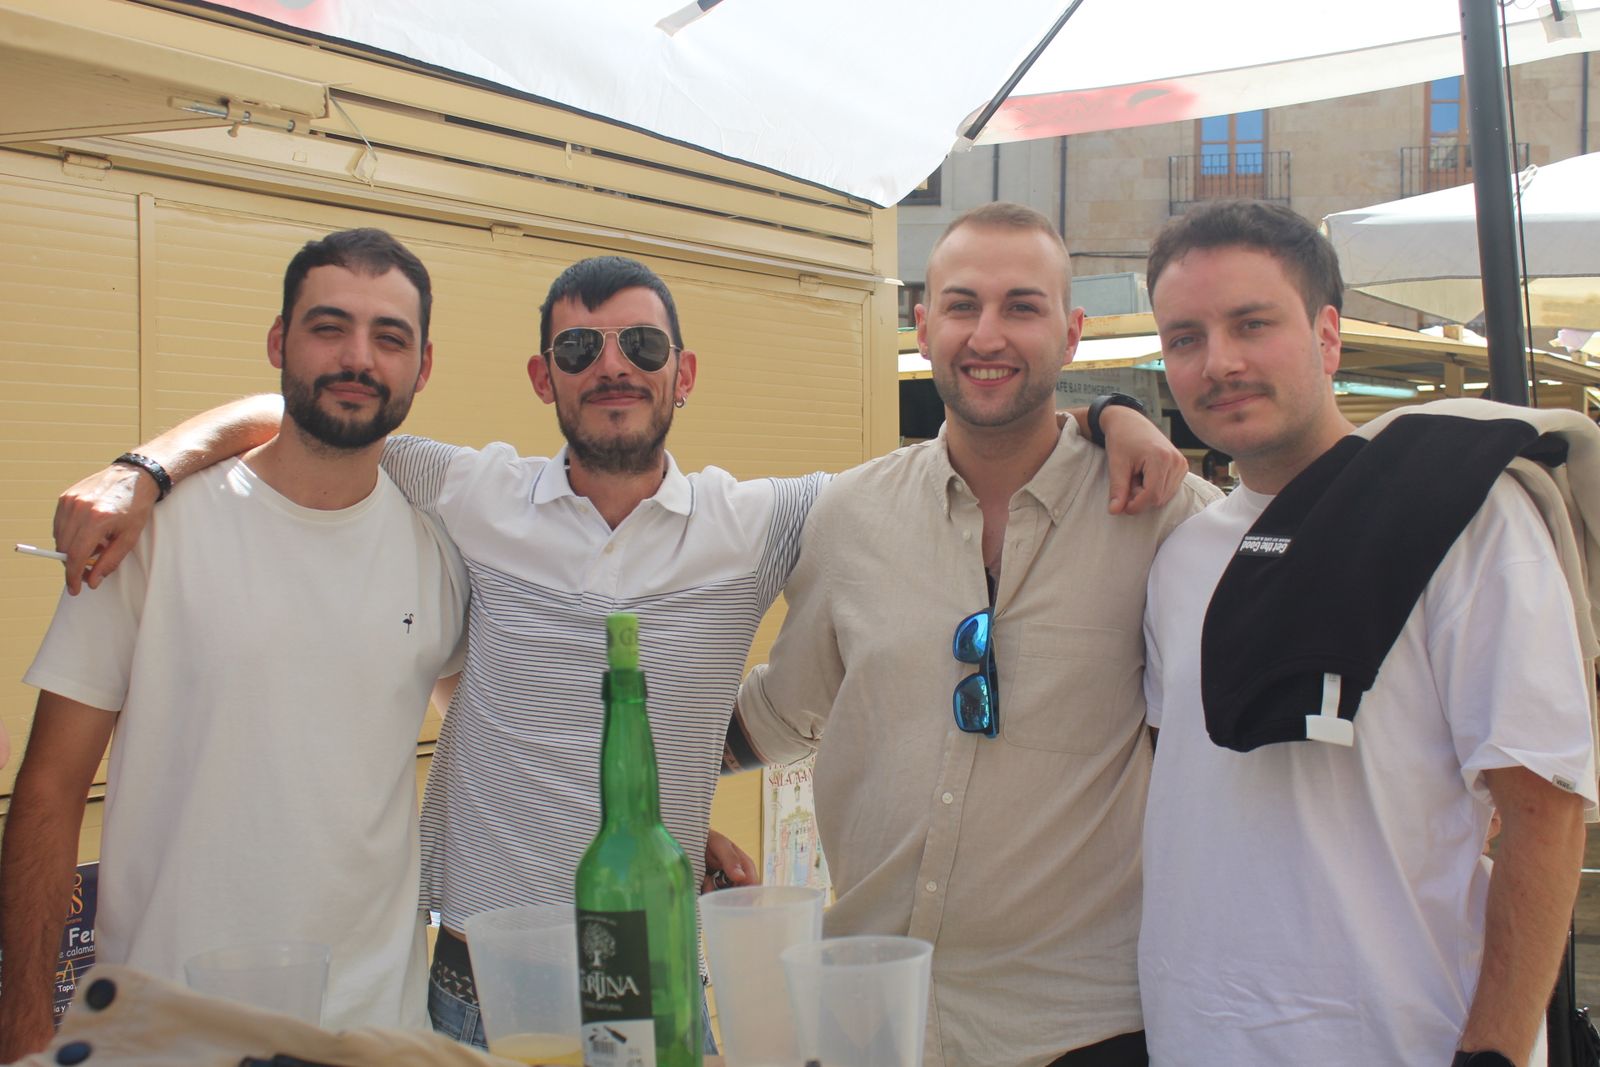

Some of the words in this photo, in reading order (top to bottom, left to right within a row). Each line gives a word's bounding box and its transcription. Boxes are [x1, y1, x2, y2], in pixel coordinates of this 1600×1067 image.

[1056, 381, 1068, 393] AFE
[1240, 540, 1260, 552] Good
[1260, 541, 1274, 553] the
[1272, 542, 1288, 554] Get
[66, 944, 95, 957] calama
[57, 984, 74, 993] Tapa
